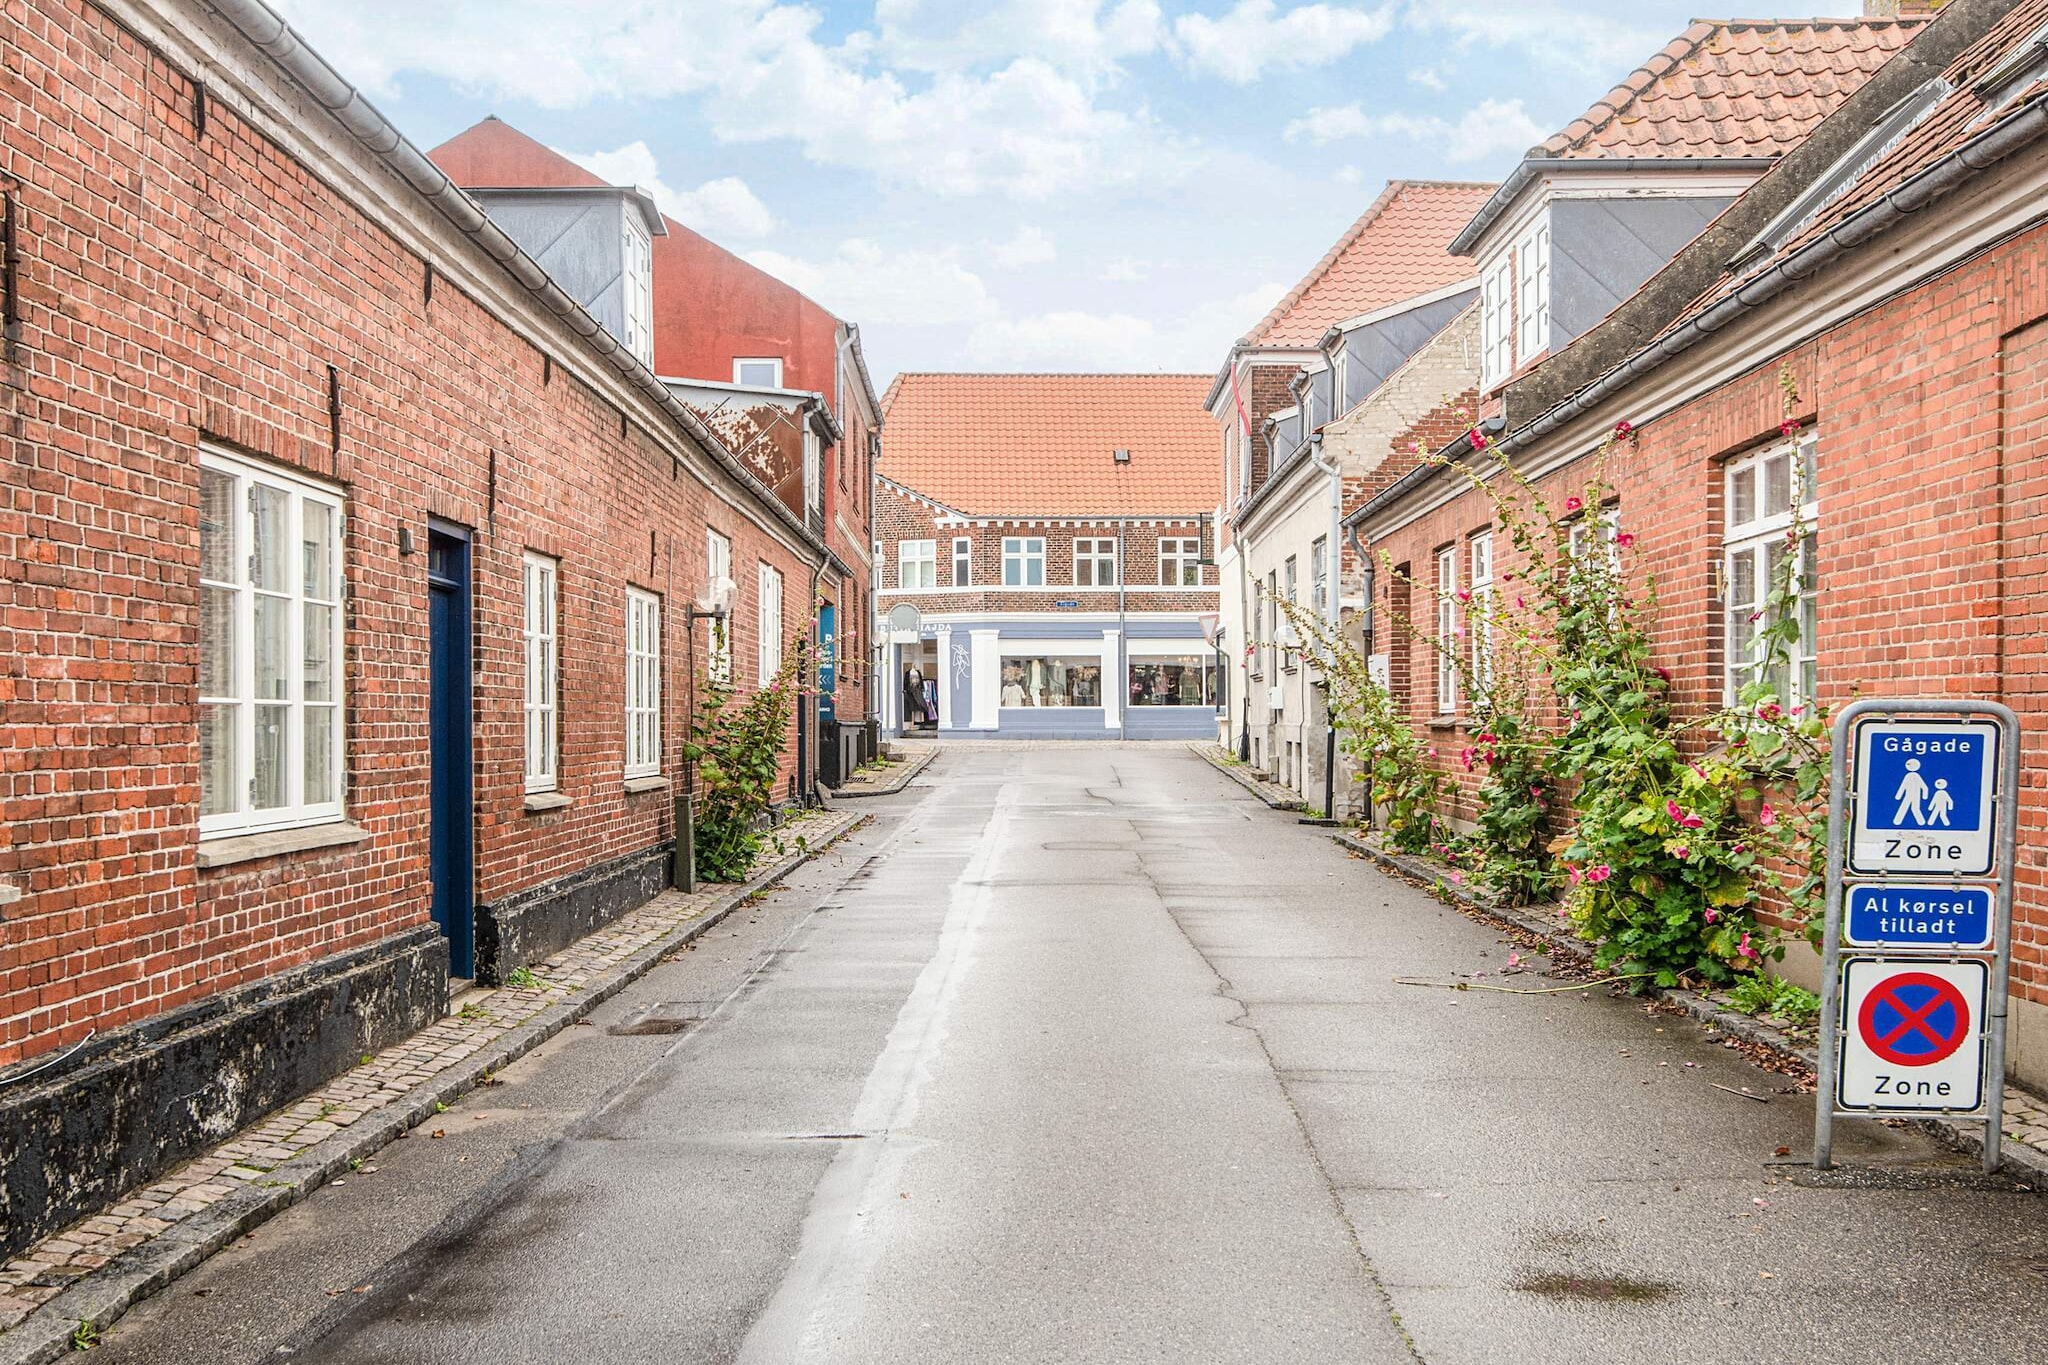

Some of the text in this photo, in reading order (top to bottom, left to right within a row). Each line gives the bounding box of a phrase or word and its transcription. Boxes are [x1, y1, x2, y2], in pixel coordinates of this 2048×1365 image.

[1884, 737, 1971, 755] Gågade
[1885, 840, 1962, 859] Zone
[1864, 897, 1974, 915] Al kørsel
[1880, 918, 1956, 934] tilladt
[1874, 1076, 1951, 1096] Zone
